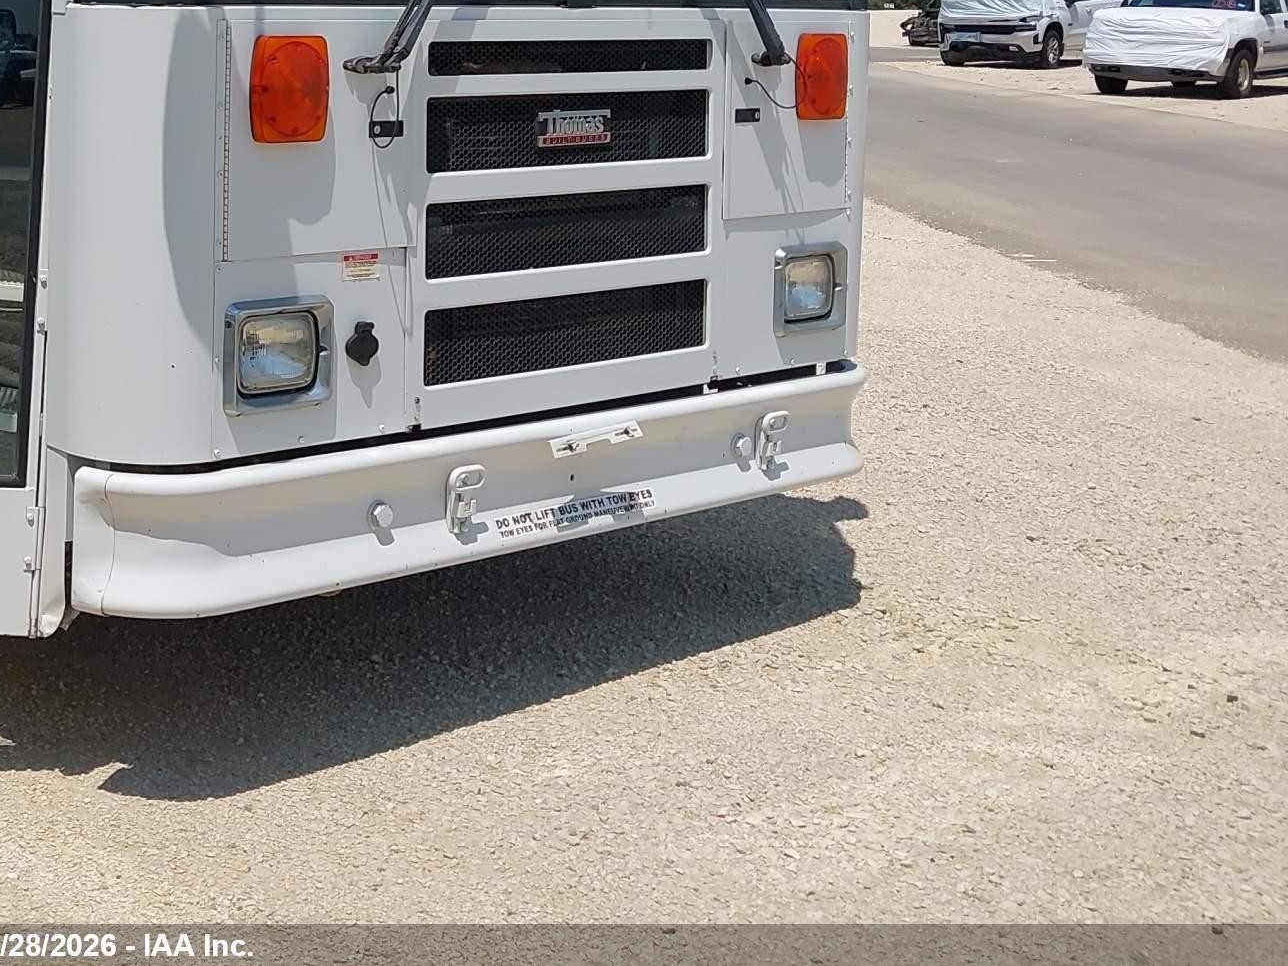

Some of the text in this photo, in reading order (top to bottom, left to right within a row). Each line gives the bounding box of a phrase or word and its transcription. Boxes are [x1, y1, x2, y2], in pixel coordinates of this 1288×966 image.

[537, 109, 611, 136] Thomas
[545, 136, 573, 144] BUILT
[495, 489, 653, 530] DO NOT LIFT BUS WITH TOW EYES
[499, 529, 515, 539] TOW
[515, 525, 533, 535] EYES
[534, 522, 549, 531] FOR
[549, 518, 565, 528] FLAT
